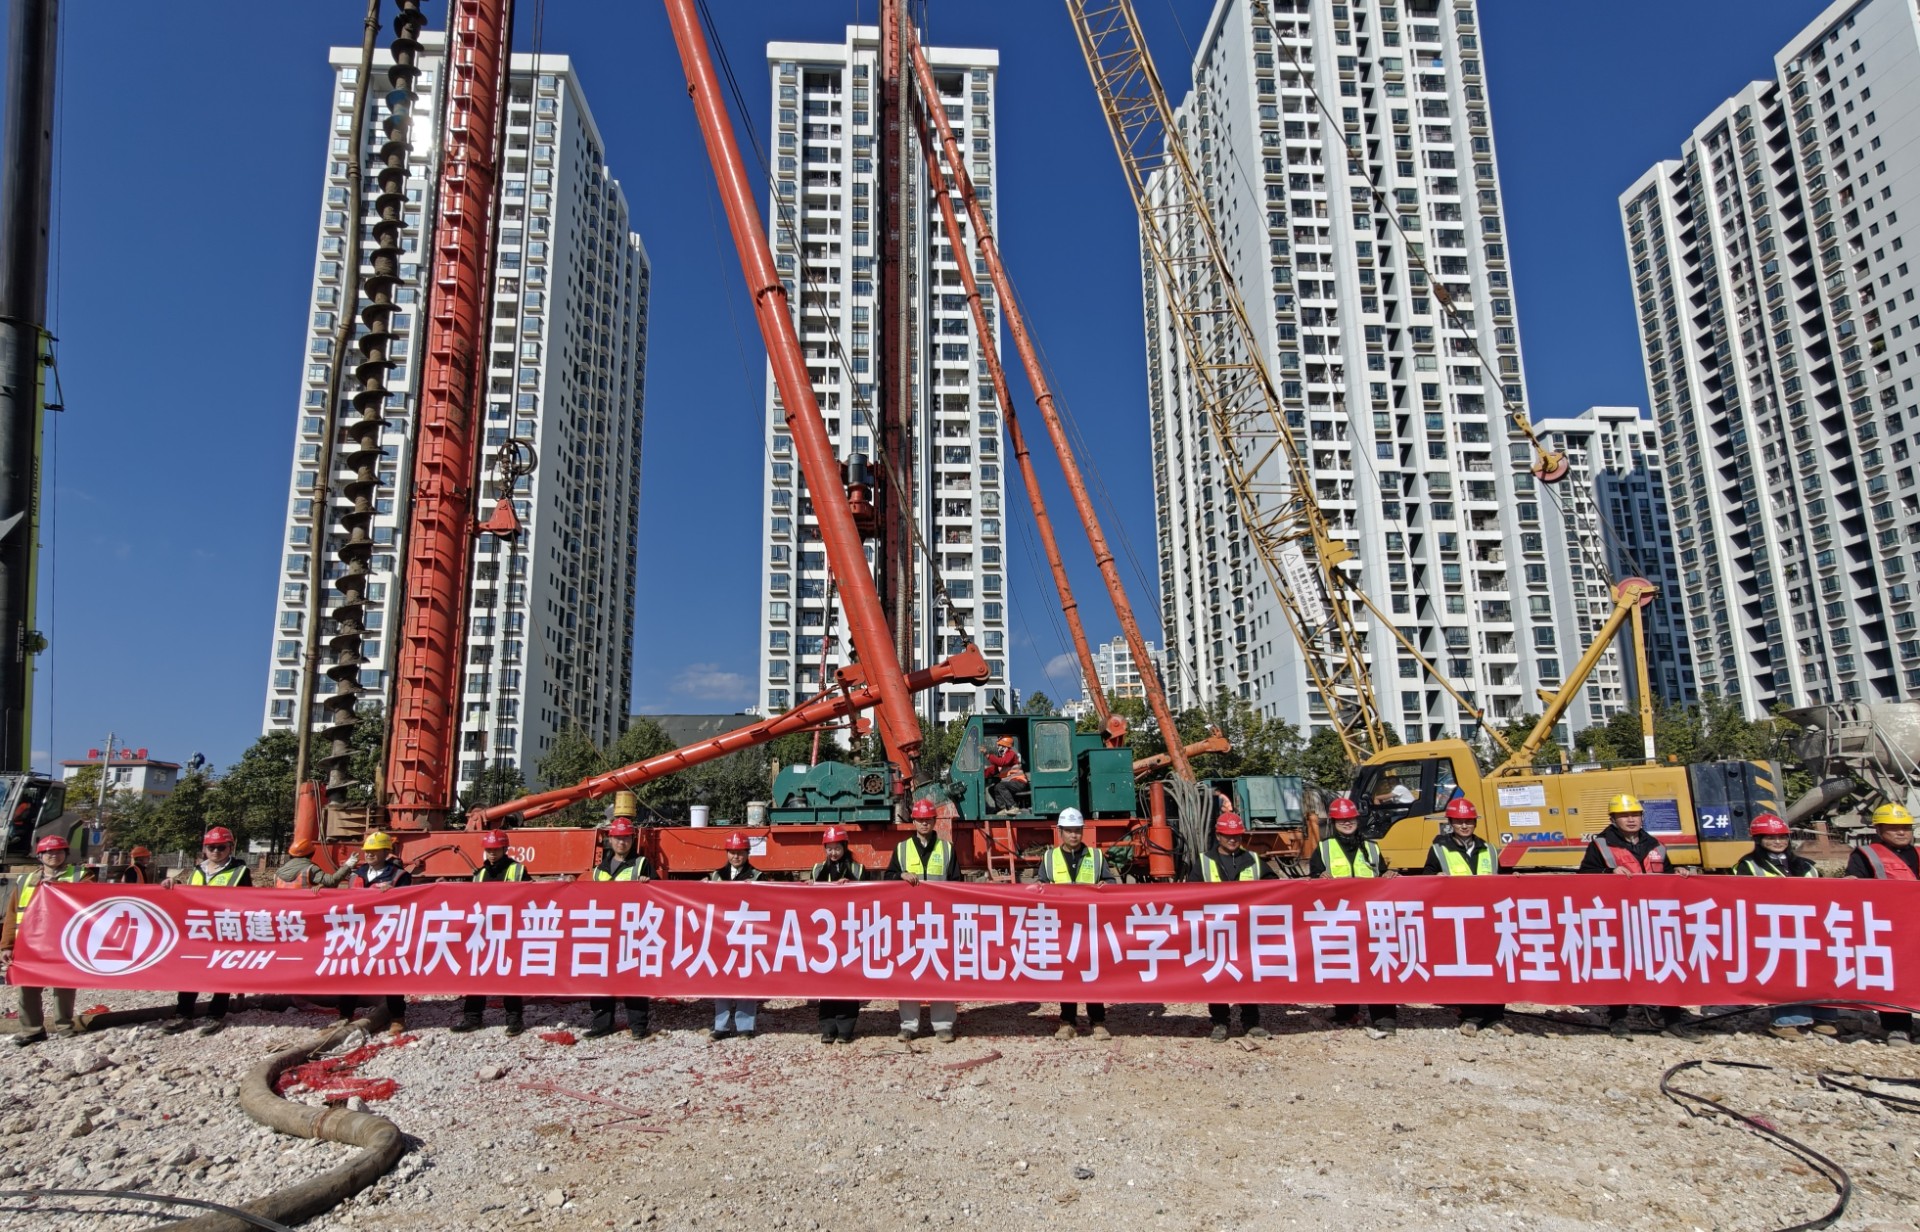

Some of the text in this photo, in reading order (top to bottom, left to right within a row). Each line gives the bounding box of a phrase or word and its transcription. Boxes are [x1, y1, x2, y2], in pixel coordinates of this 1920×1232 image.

[1701, 814, 1729, 829] 2#
[1516, 831, 1565, 843] XCMG
[185, 908, 310, 943] 云南建投
[315, 896, 1894, 992] 热烈庆祝普吉路以东A3地块配建小学项目首颗工程桩顺利开钻
[206, 949, 277, 970] YCIH
